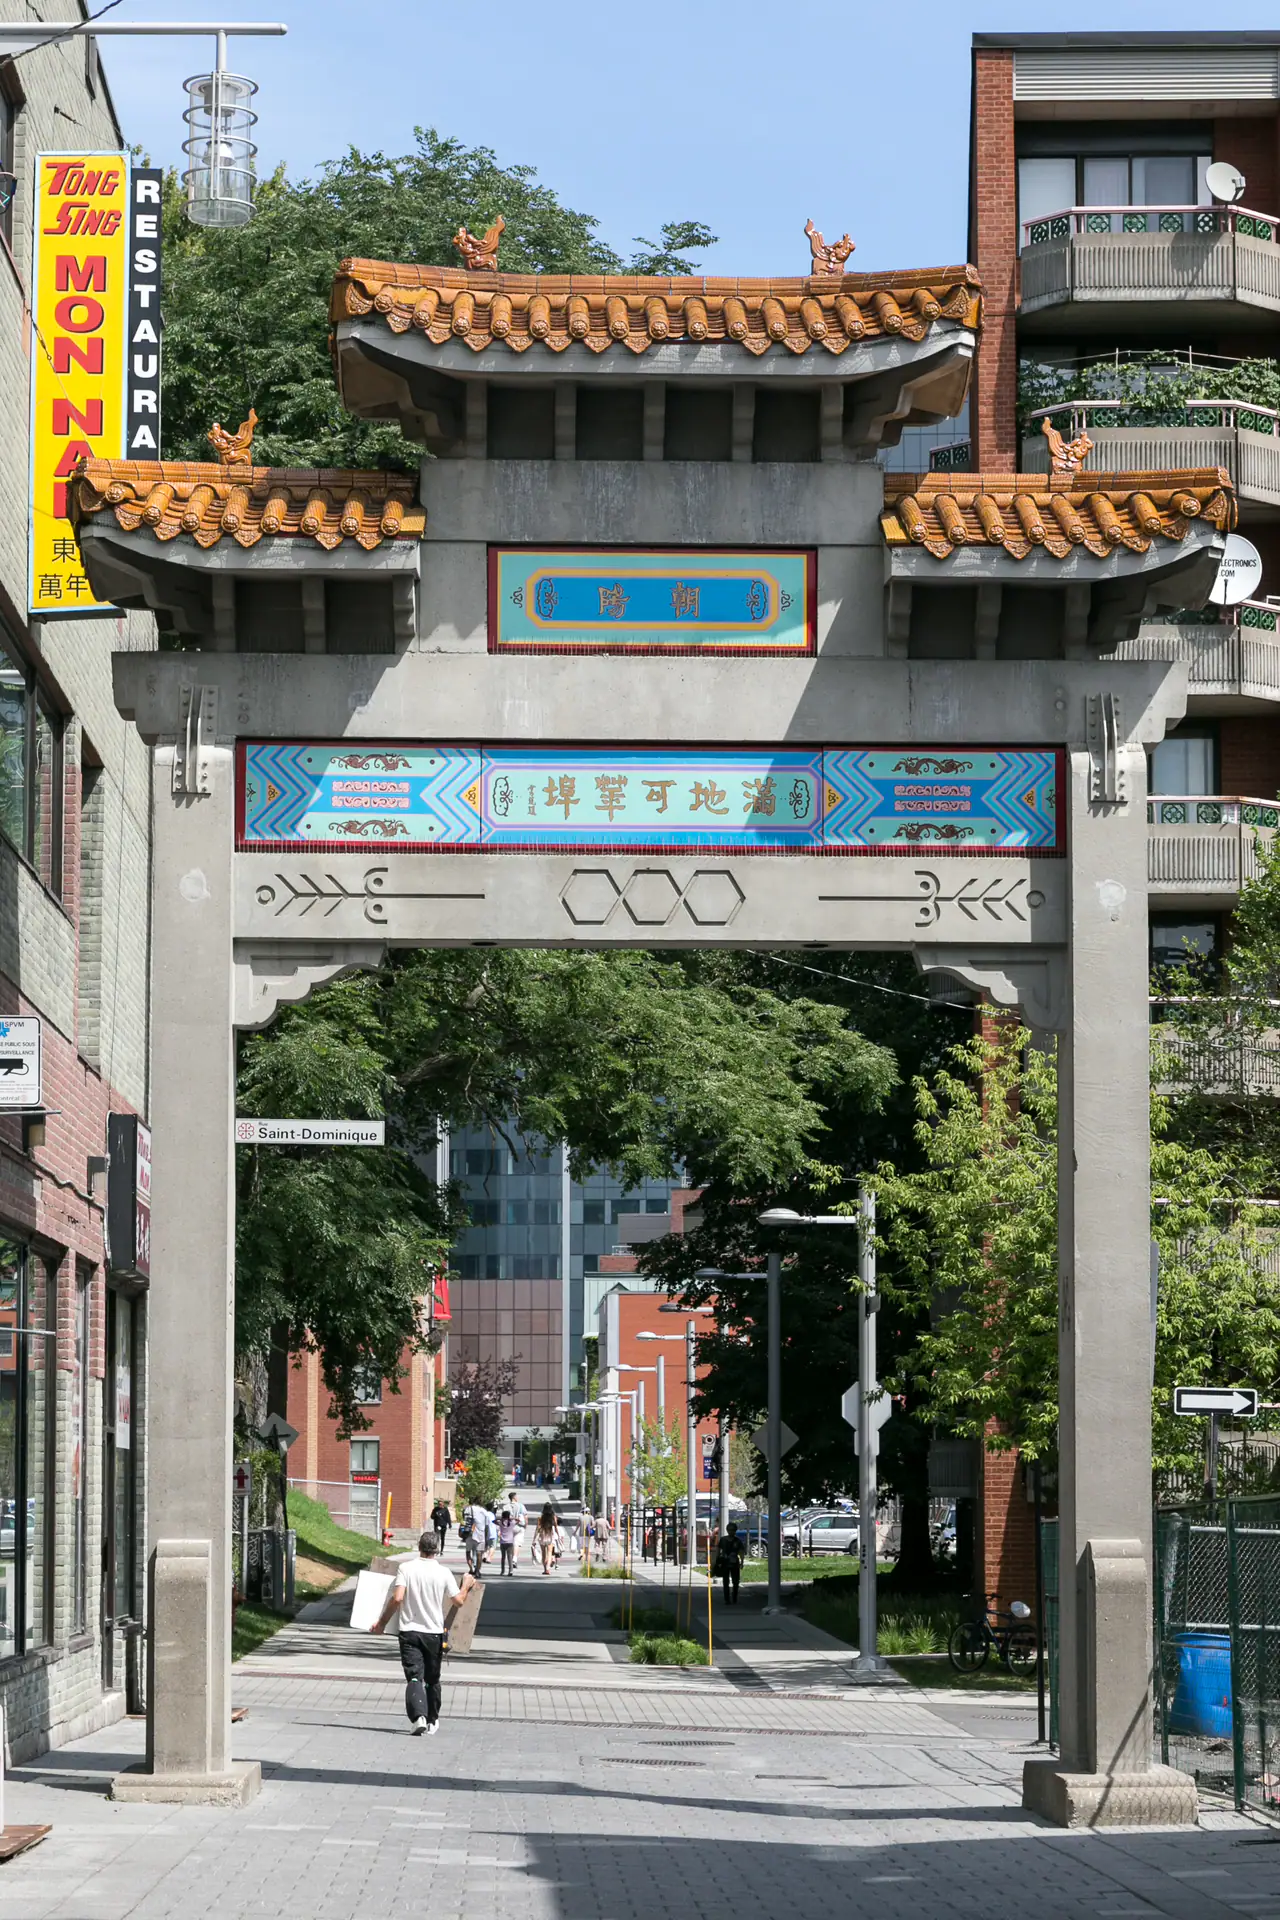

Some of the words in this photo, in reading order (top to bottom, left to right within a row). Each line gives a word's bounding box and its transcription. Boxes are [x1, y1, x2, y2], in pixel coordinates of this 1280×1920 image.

[45, 162, 120, 196] TONG
[43, 201, 122, 236] SING
[52, 537, 80, 563] 東
[38, 573, 88, 600] 萬年
[258, 1128, 377, 1142] Saint-Dominique
